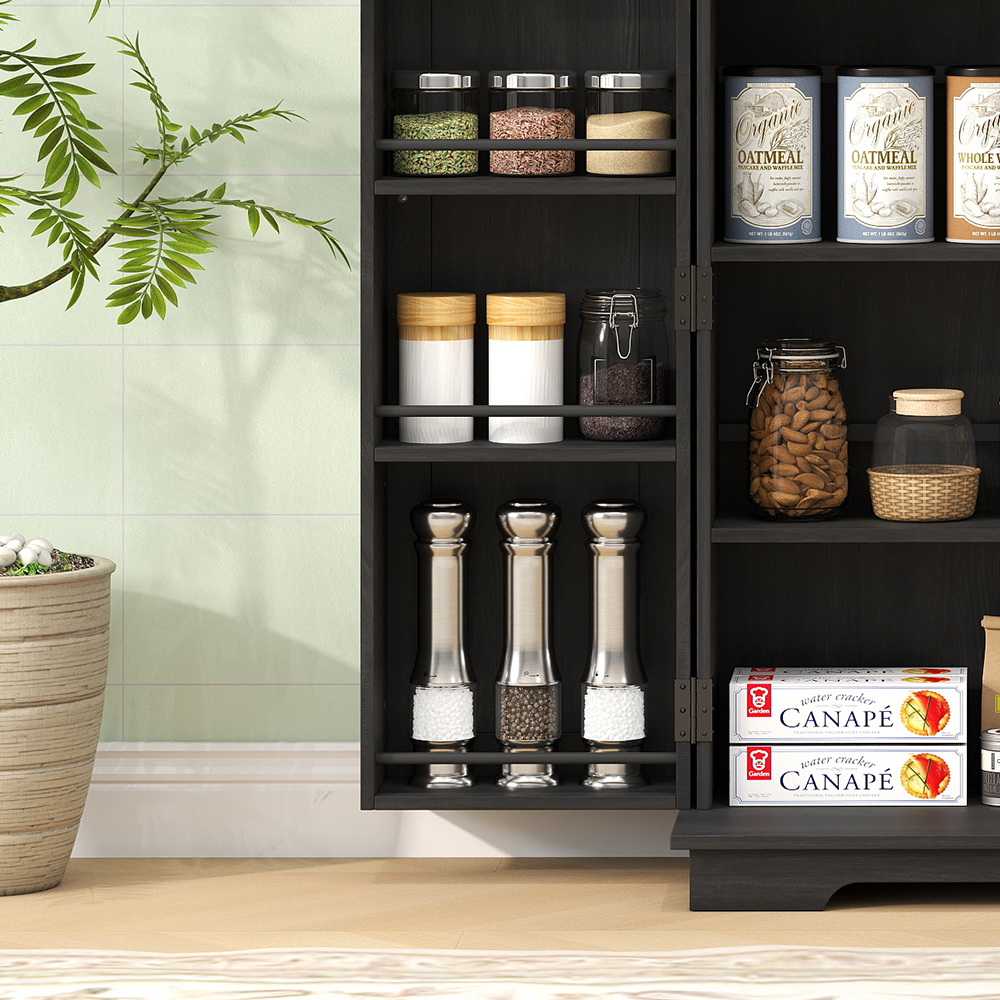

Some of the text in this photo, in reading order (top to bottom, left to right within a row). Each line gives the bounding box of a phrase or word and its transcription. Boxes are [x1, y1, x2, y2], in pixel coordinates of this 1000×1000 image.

[736, 100, 802, 149] Organic
[849, 100, 916, 149] Organic
[738, 150, 804, 164] OATMEAL
[851, 150, 917, 164] OATMEAL
[958, 152, 994, 164] WHOLE
[801, 692, 876, 706] water cracker
[780, 705, 894, 728] CANAPÉ
[801, 755, 876, 769] water cracker
[780, 768, 894, 791] CANAPÉ
